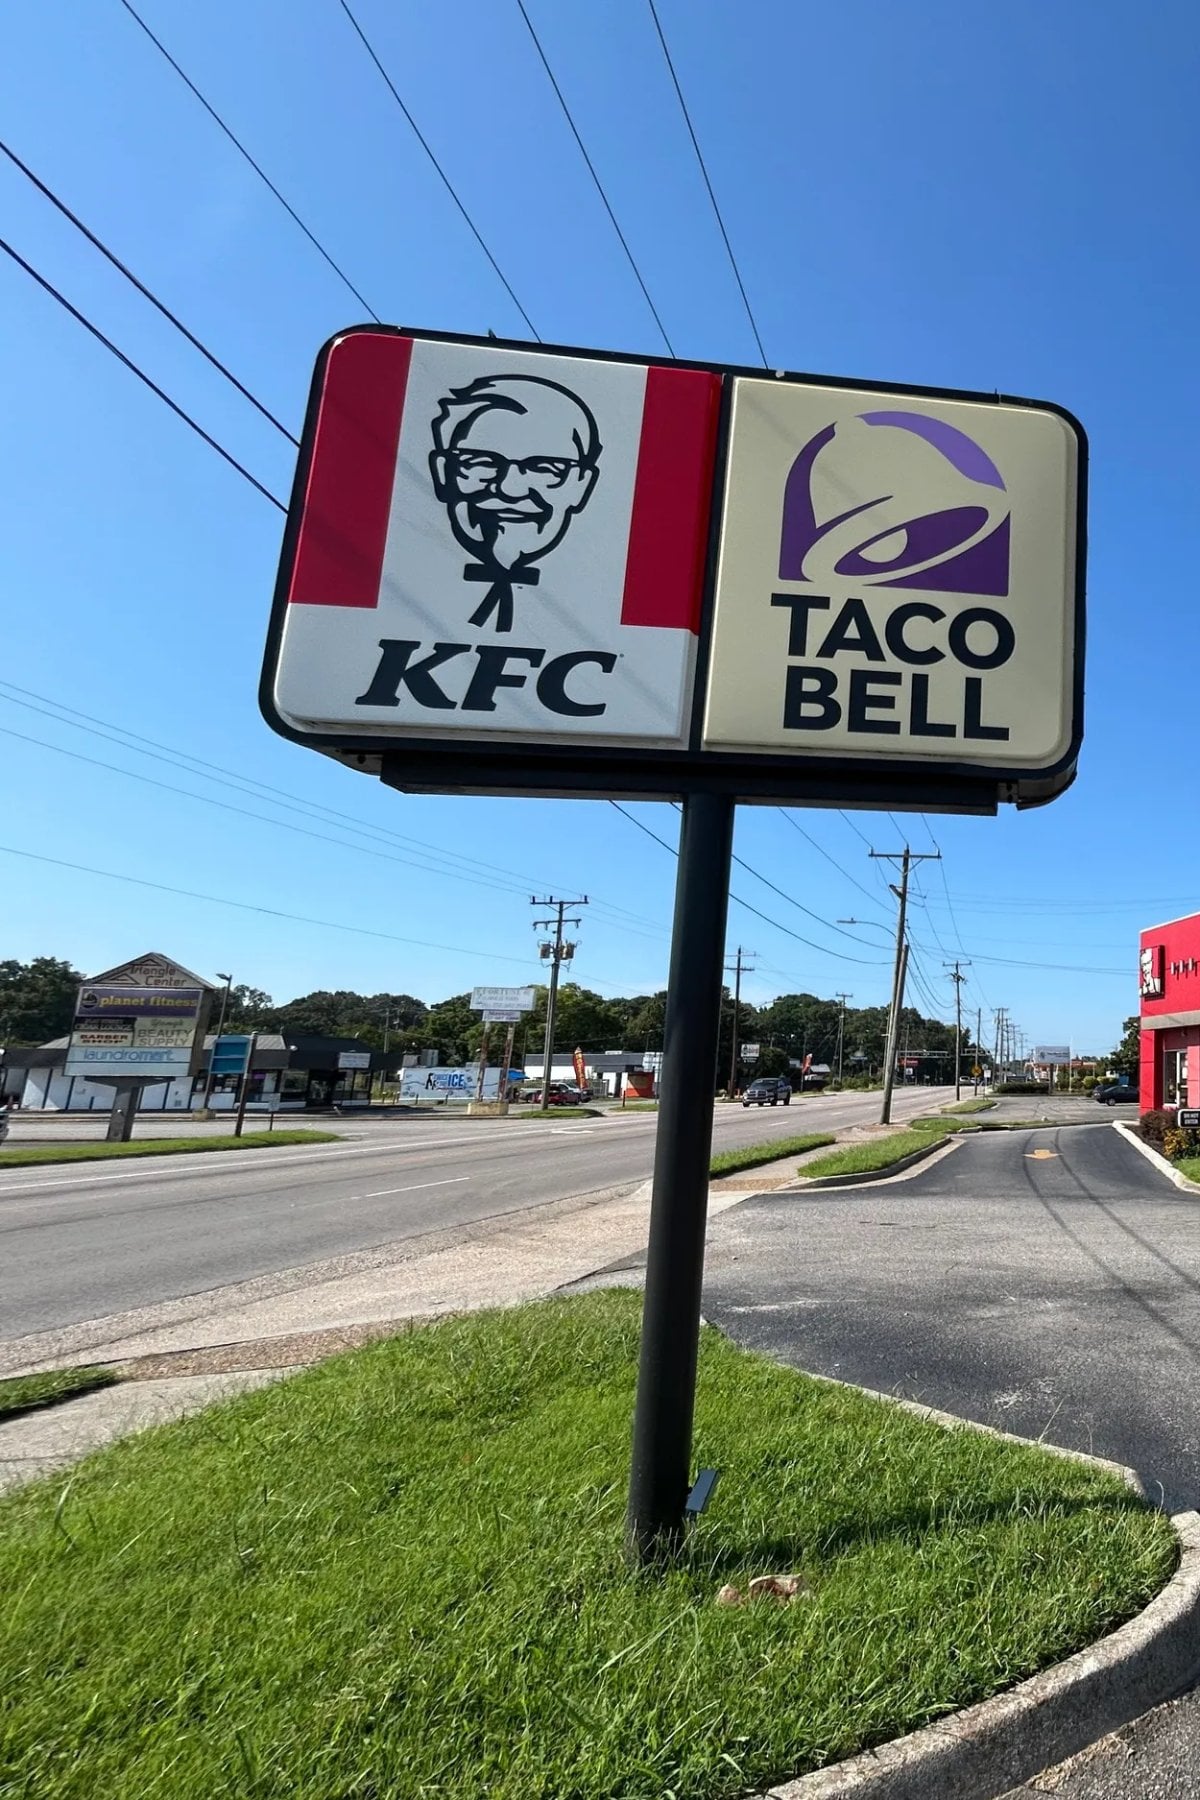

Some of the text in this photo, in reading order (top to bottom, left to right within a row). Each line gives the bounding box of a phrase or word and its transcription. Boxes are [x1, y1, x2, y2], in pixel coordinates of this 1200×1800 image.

[771, 593, 1016, 671] TACO
[355, 639, 618, 717] KFC
[783, 665, 1010, 742] BELL
[130, 963, 176, 977] Triangle
[145, 975, 188, 986] Center
[100, 996, 197, 1007] planet fitness
[138, 1029, 193, 1037] BEAUTY
[139, 1038, 188, 1046] SUPPLY
[448, 1074, 465, 1087] ICE
